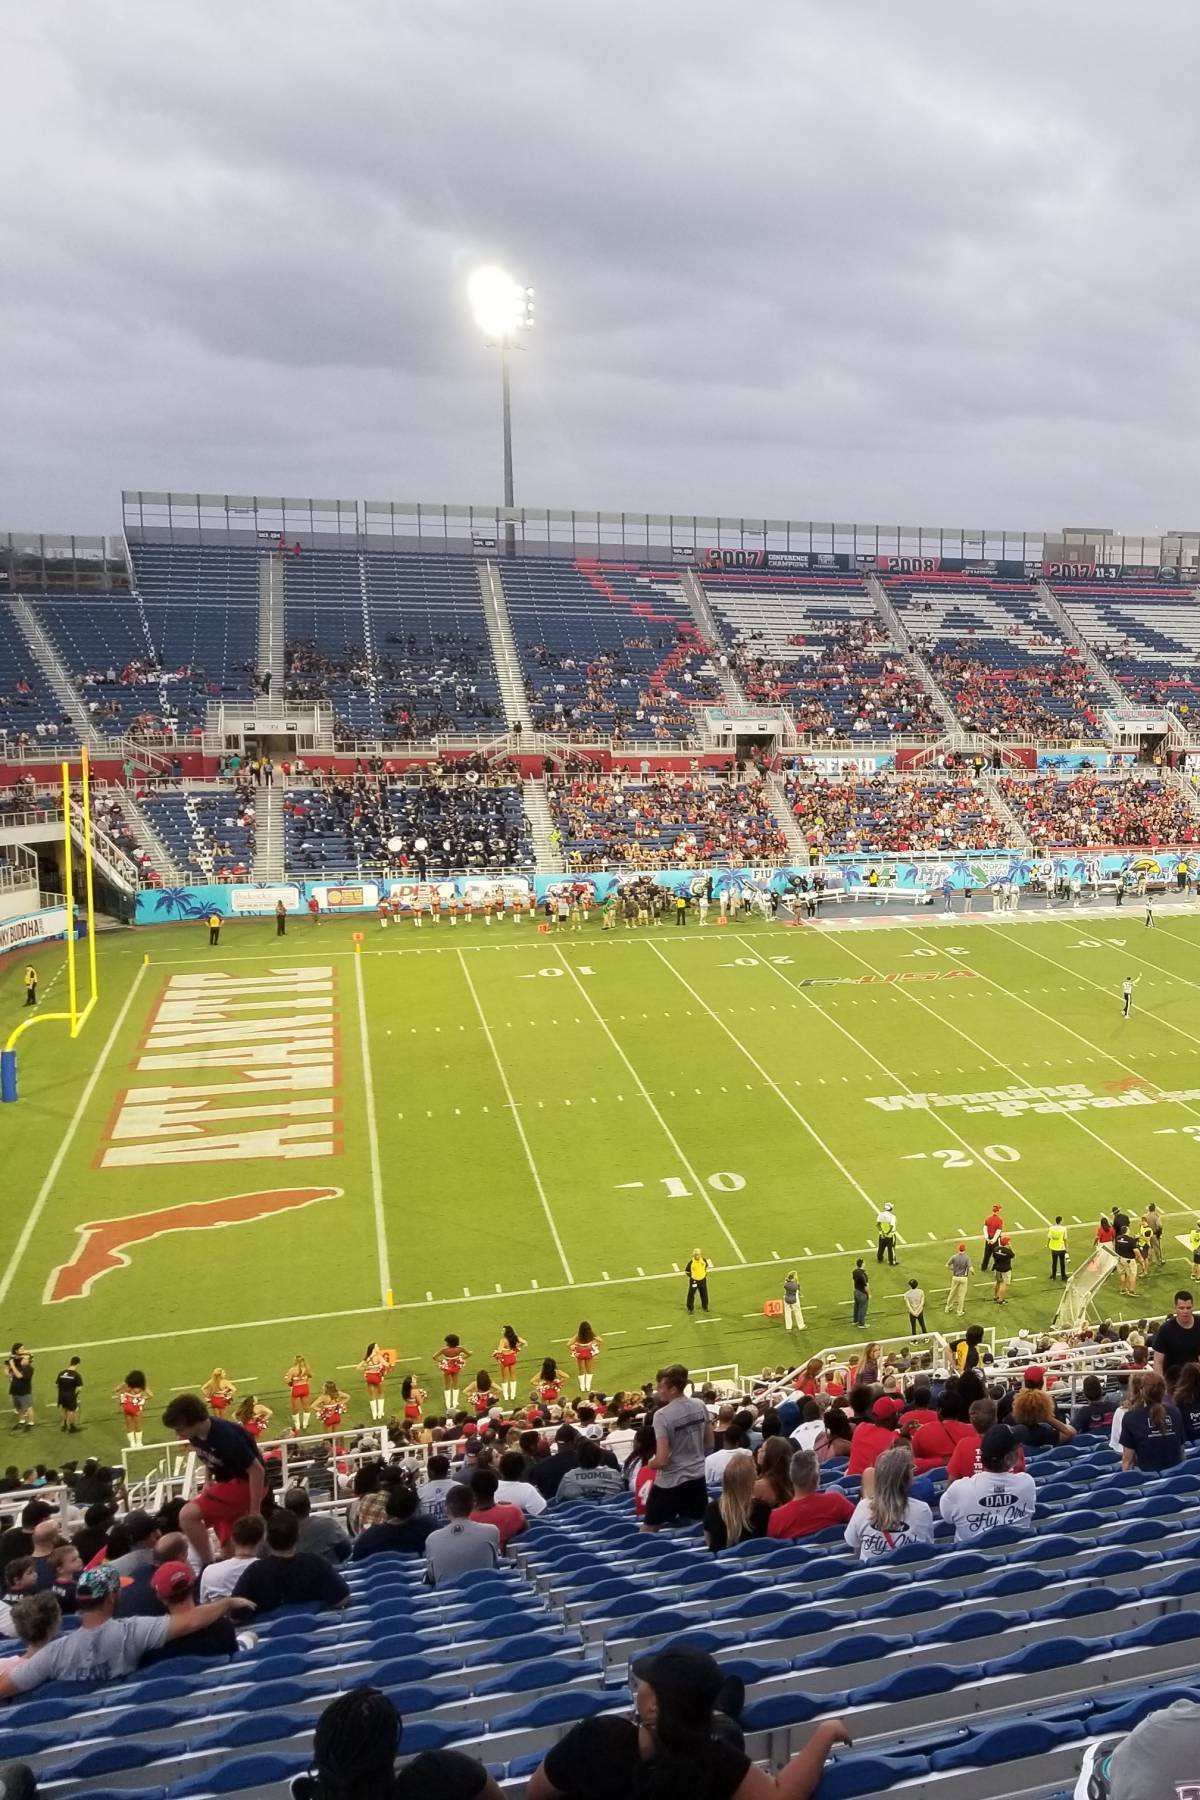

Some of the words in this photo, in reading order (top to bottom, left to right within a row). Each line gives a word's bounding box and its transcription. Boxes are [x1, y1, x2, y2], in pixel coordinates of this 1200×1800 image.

[710, 550, 759, 568] 2007
[768, 554, 809, 562] CONFERENCE
[888, 557, 935, 572] 2008
[1051, 563, 1090, 578] 2017
[1095, 567, 1116, 578] 11-3
[754, 870, 772, 879] FIU
[10, 919, 40, 943] BUDDHA
[864, 1083, 1095, 1111] Winning
[962, 1104, 993, 1114] in
[932, 1144, 1021, 1168] 20
[660, 1172, 747, 1198] 10
[767, 1302, 781, 1313] 10
[986, 1494, 1012, 1507] DAD
[966, 1512, 998, 1532] Fly
[1004, 1503, 1027, 1524] Girl
